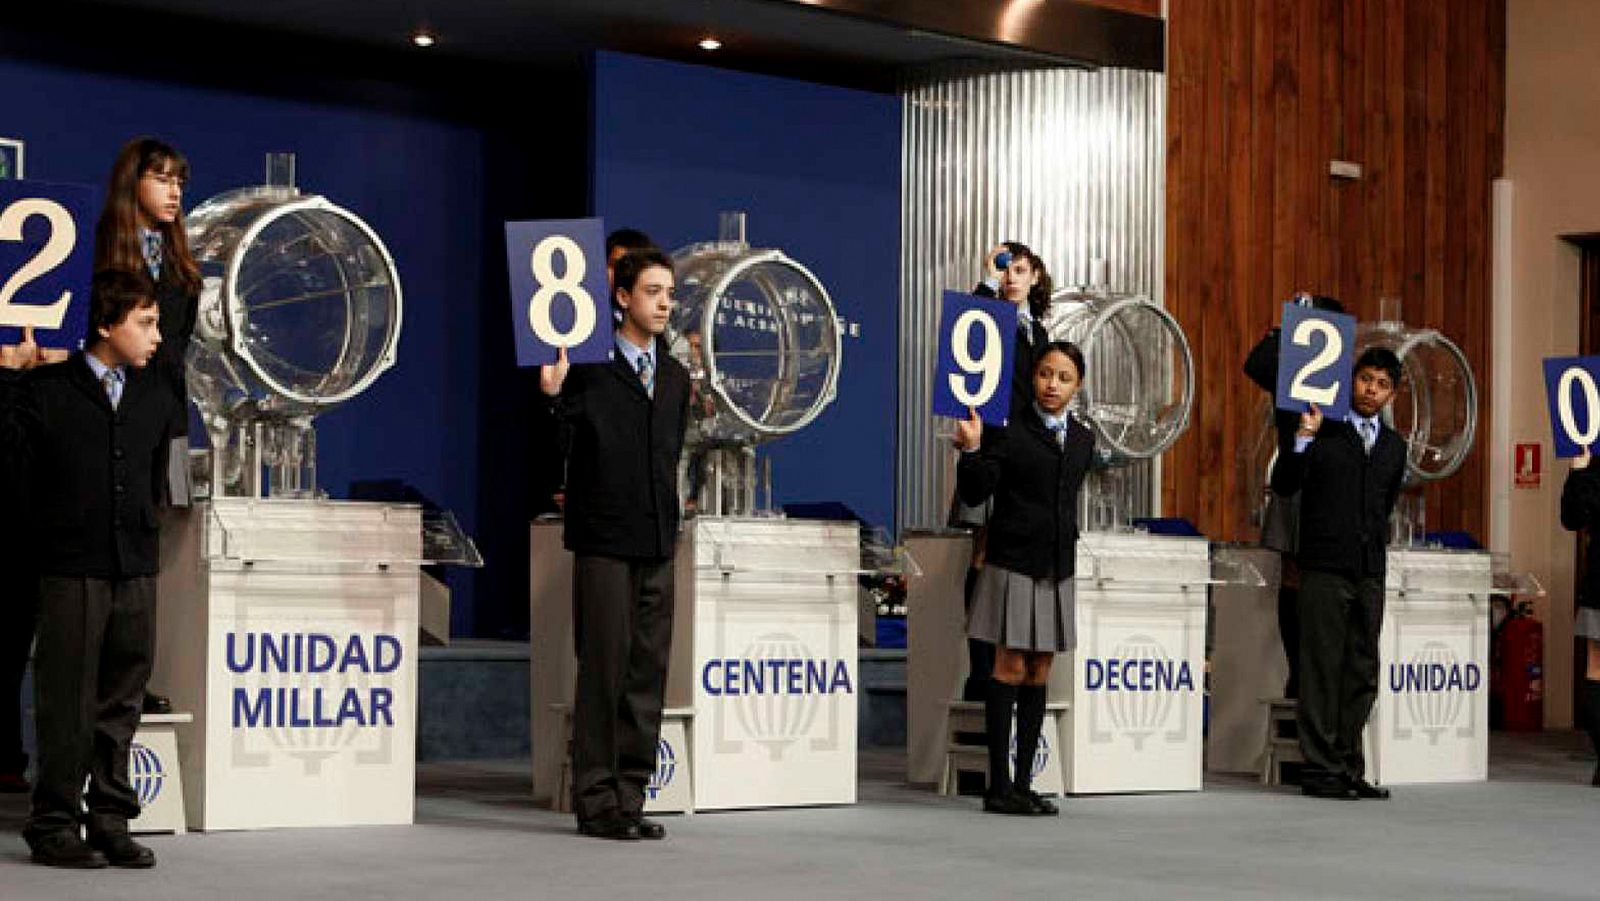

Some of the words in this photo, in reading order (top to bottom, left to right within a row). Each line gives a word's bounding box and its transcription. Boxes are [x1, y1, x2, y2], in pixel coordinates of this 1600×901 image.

[0, 198, 76, 328] 2
[530, 235, 597, 347] 8
[948, 309, 1002, 406] 9
[1290, 318, 1343, 406] 2
[1558, 367, 1600, 445] 0
[225, 632, 403, 674] UNIDAD
[702, 658, 853, 696] CENTENA
[1085, 658, 1195, 692] DECENA
[1389, 663, 1481, 695] UNIDAD
[231, 687, 394, 728] MILLAR
